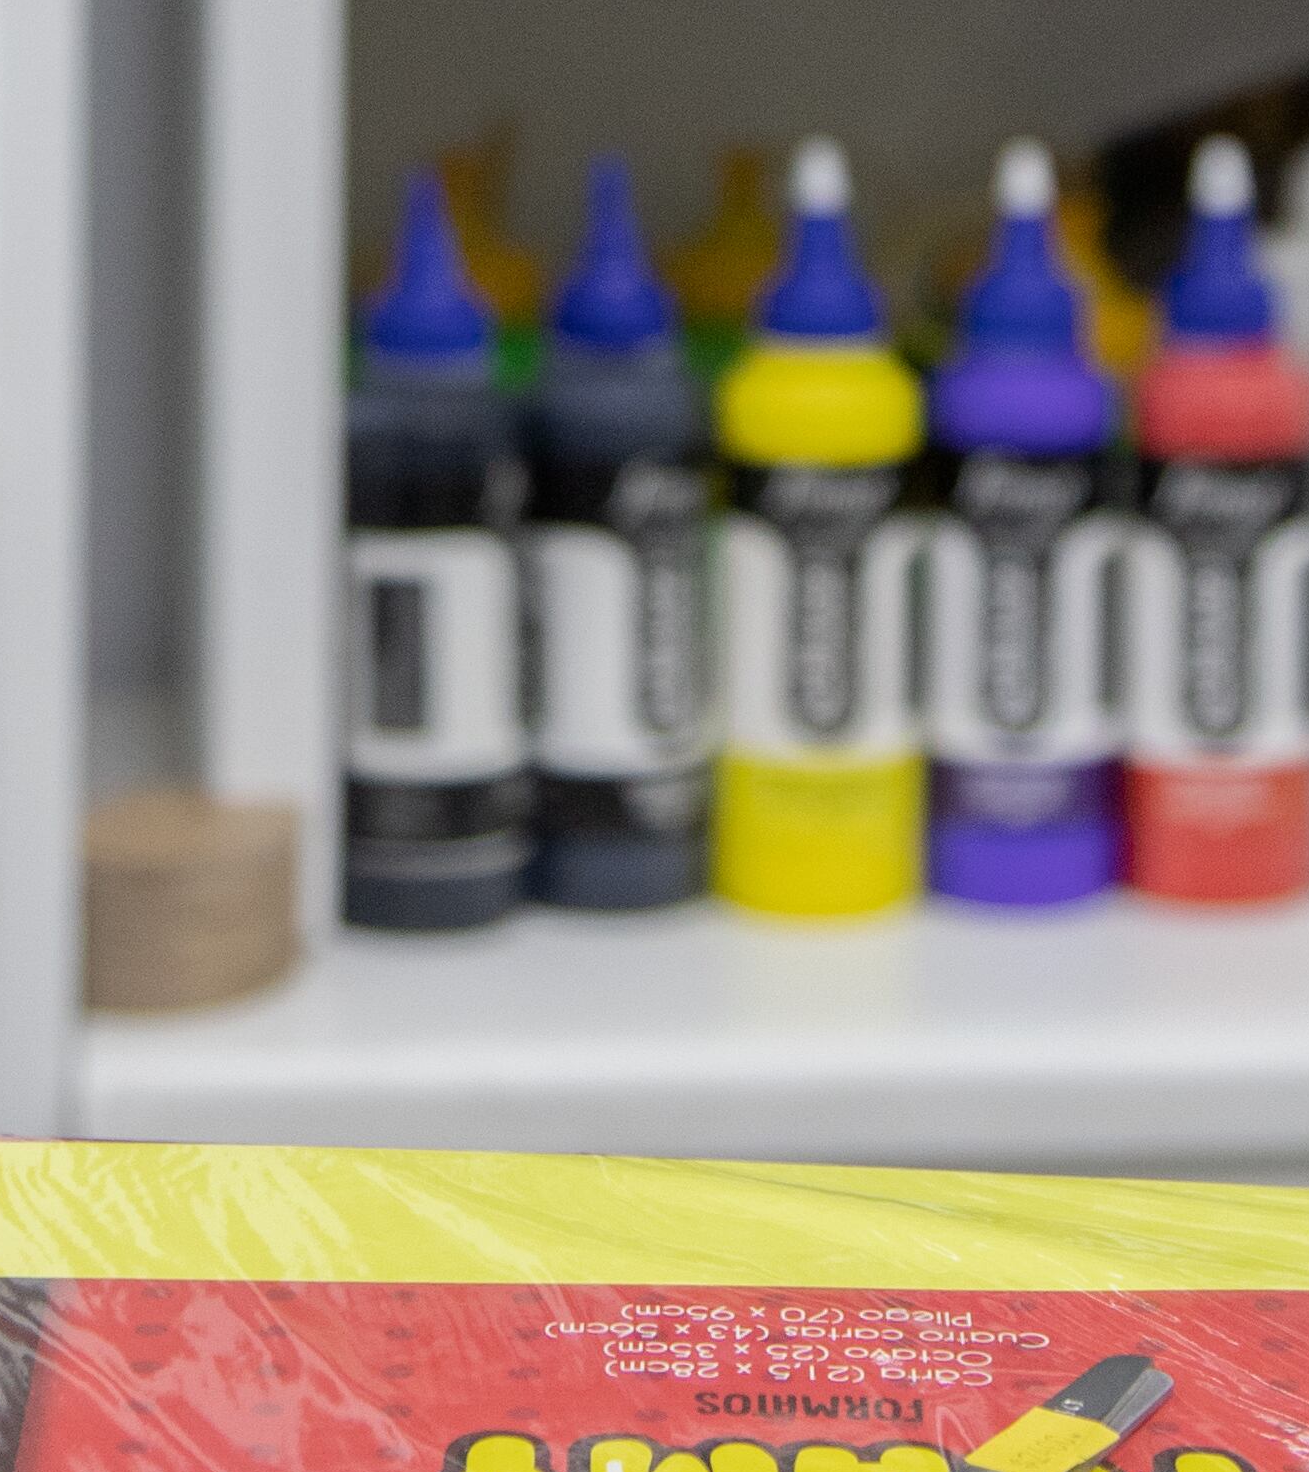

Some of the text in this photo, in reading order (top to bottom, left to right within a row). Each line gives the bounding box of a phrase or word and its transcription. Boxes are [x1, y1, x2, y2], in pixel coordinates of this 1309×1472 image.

[621, 1303, 972, 1328] Pliego (70 x 95cm)
[544, 1320, 1050, 1349] Cuatro cartas (43 x 56cm)
[603, 1340, 992, 1367] Octavo (25 x 35cm)
[604, 1359, 719, 1378] 28cm)
[735, 1362, 752, 1376] x
[694, 1392, 923, 1423] FORMATOS
